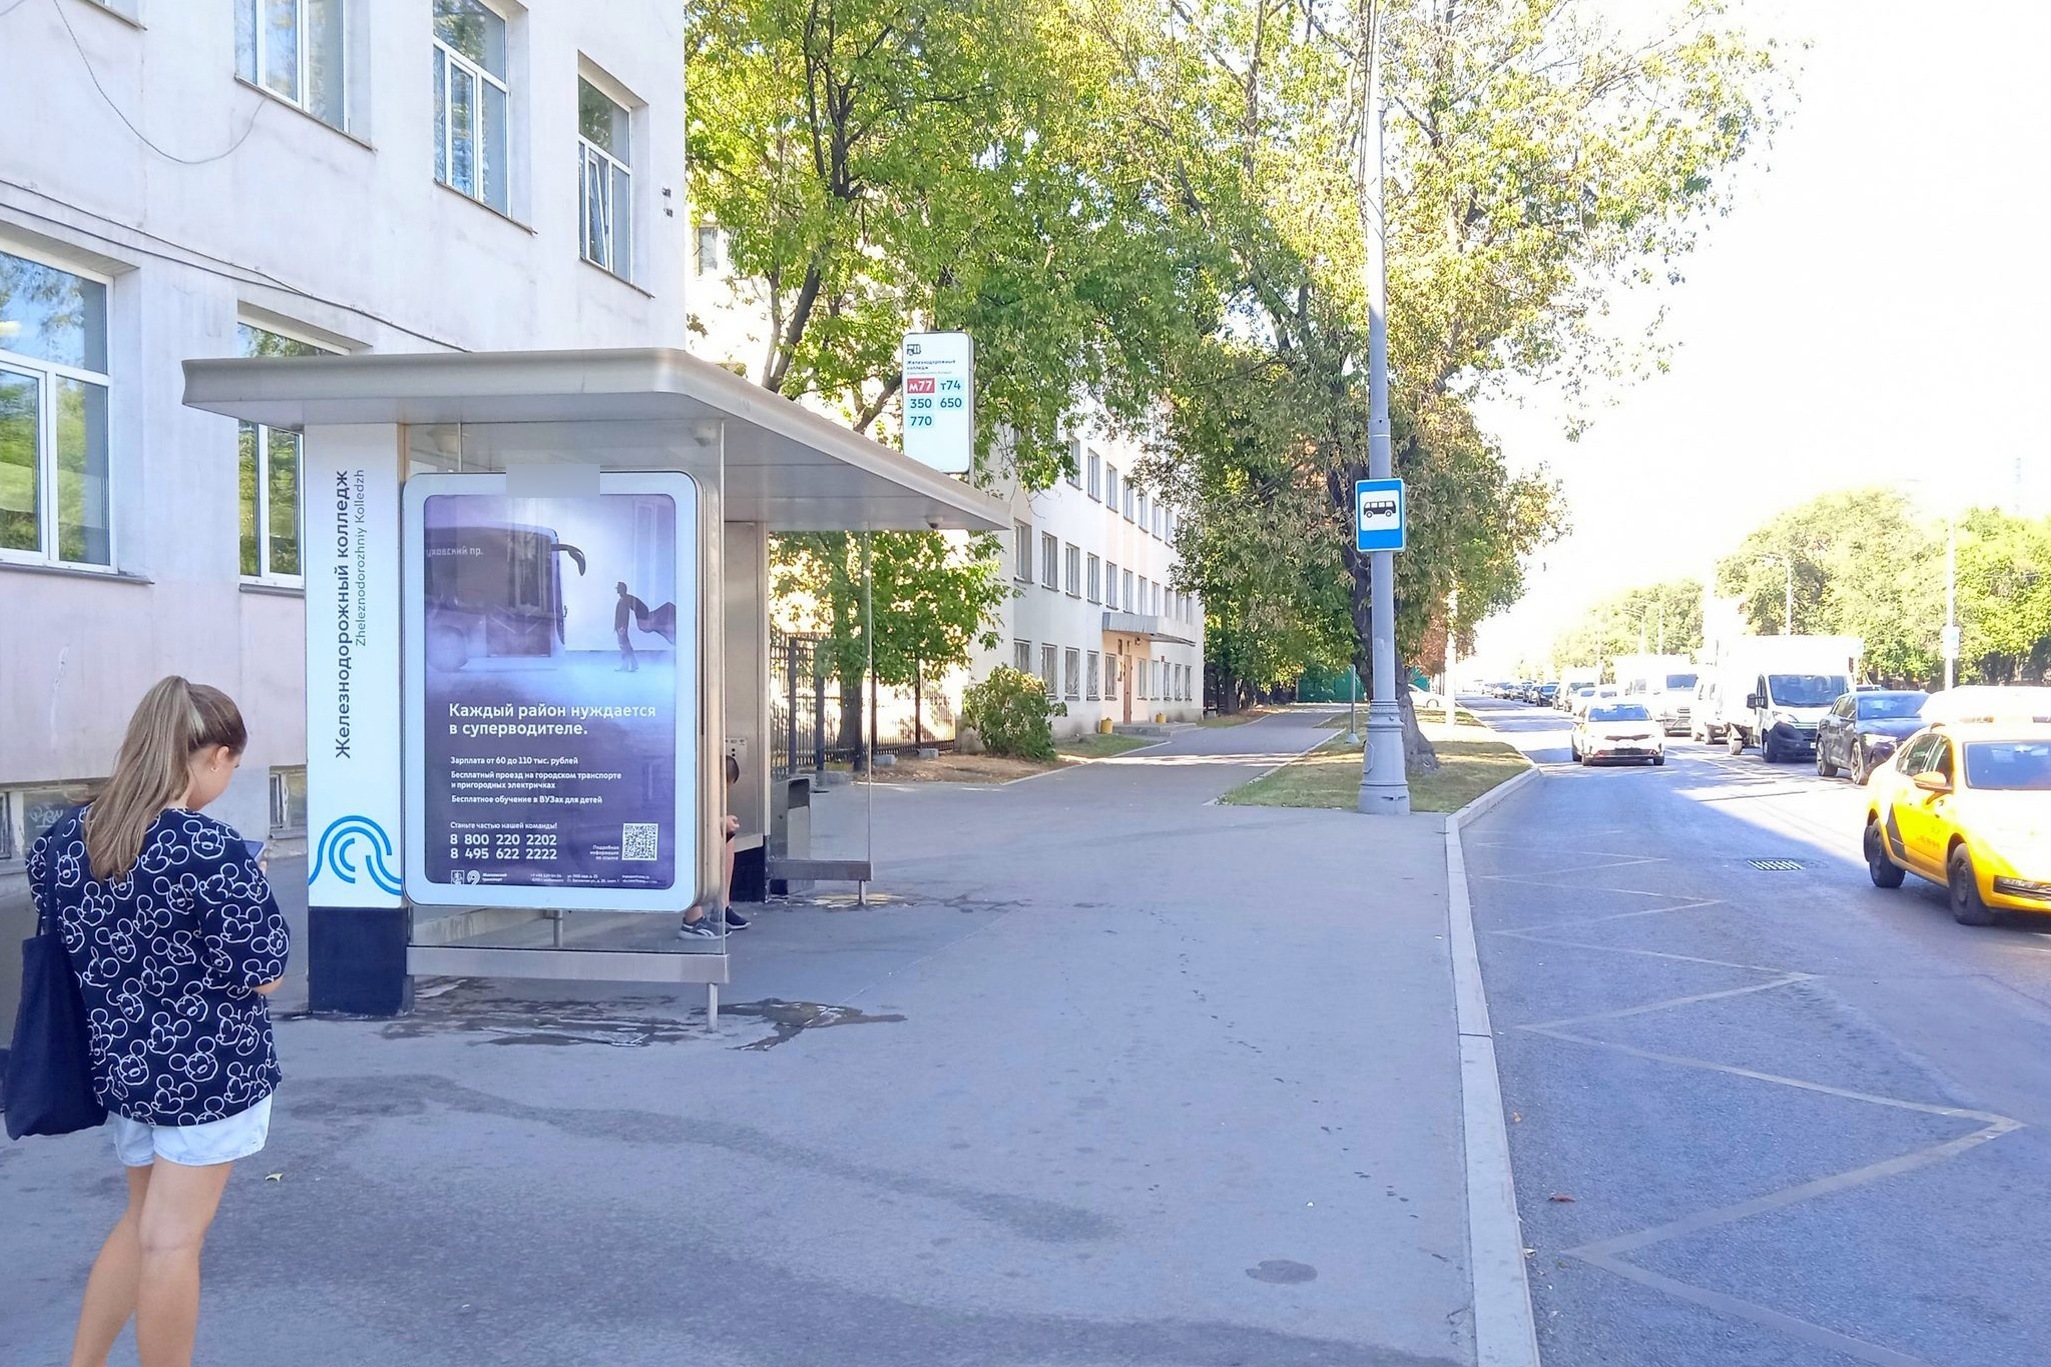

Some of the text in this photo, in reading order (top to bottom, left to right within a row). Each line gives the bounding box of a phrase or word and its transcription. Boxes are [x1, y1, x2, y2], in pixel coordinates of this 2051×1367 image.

[940, 380, 960, 390] т74
[910, 398, 962, 408] 350 650
[910, 416, 932, 426] 770
[354, 469, 367, 646] Zheleznodorozhniy Kolledzh
[334, 470, 352, 759] Железнодорожный колледж
[449, 703, 656, 720] Каждый район нуждается
[449, 724, 588, 737] в суперводителе.
[450, 756, 486, 765] Зарплата
[496, 756, 506, 764] 60
[518, 756, 532, 764] 110
[550, 756, 578, 766] рублей
[450, 770, 494, 778] Бесплатный
[496, 772, 524, 780] проезд
[535, 772, 576, 780] городском
[457, 782, 506, 790] пригородных
[507, 782, 556, 790] электричках
[452, 795, 494, 803] Бесплатное
[494, 796, 532, 804] обучение
[580, 796, 602, 804] детей
[525, 822, 558, 830] команды!
[450, 834, 558, 846] 8 800 220 2202
[450, 848, 558, 860] 8 495 622 2222
